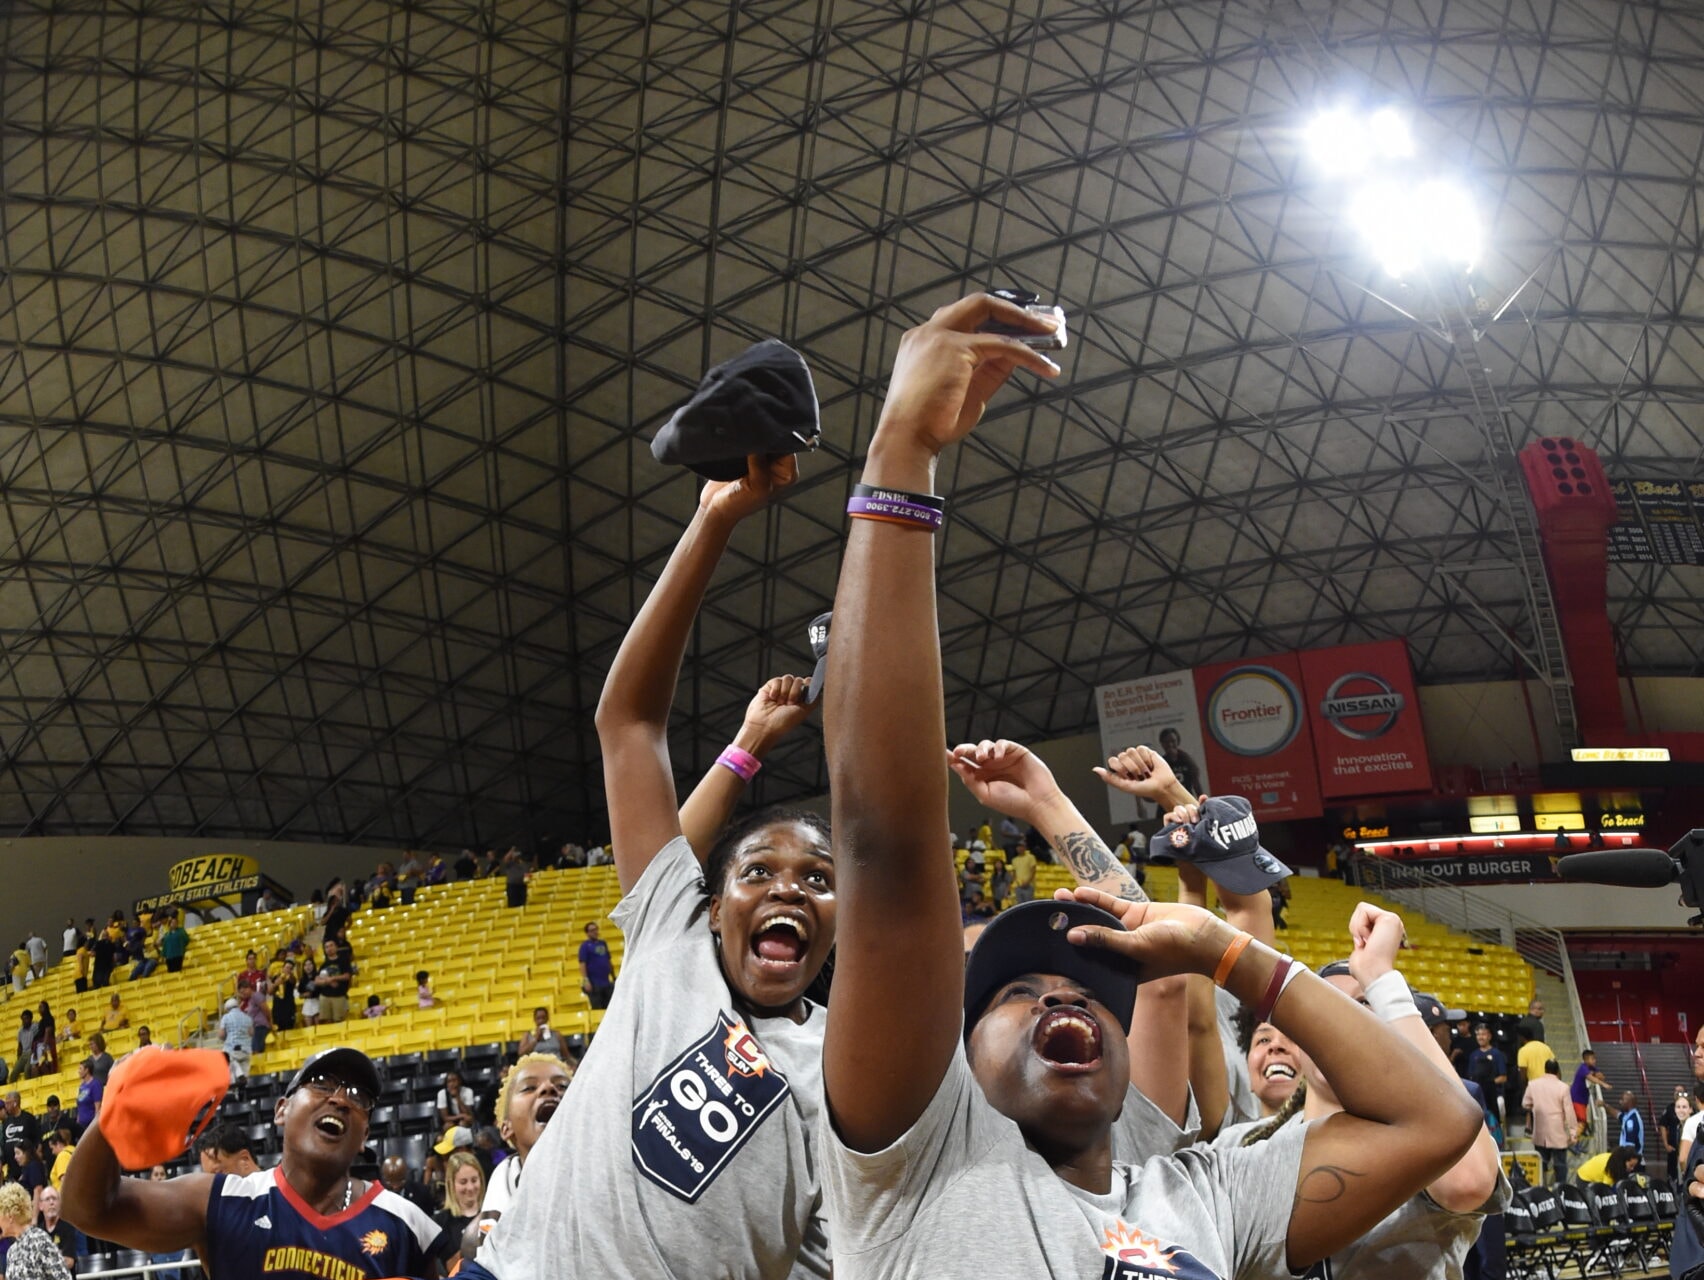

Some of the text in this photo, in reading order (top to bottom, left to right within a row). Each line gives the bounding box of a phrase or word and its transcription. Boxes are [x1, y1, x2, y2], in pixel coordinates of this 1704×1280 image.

[1221, 704, 1283, 722] Frontier
[1328, 697, 1397, 714] NISSAN
[1333, 761, 1414, 775] that excites
[1337, 752, 1407, 766] Innovation
[1219, 811, 1257, 844] FINA
[1601, 813, 1614, 828] Go
[1615, 813, 1645, 827] Beach
[1343, 827, 1356, 839] Go
[1391, 860, 1532, 879] IN-N-OUT BURGER
[186, 886, 211, 901] STATE
[213, 875, 260, 895] ATHLETICS
[727, 1051, 750, 1074] SUN
[694, 1051, 755, 1117] THREE TO
[670, 1069, 739, 1143] GO
